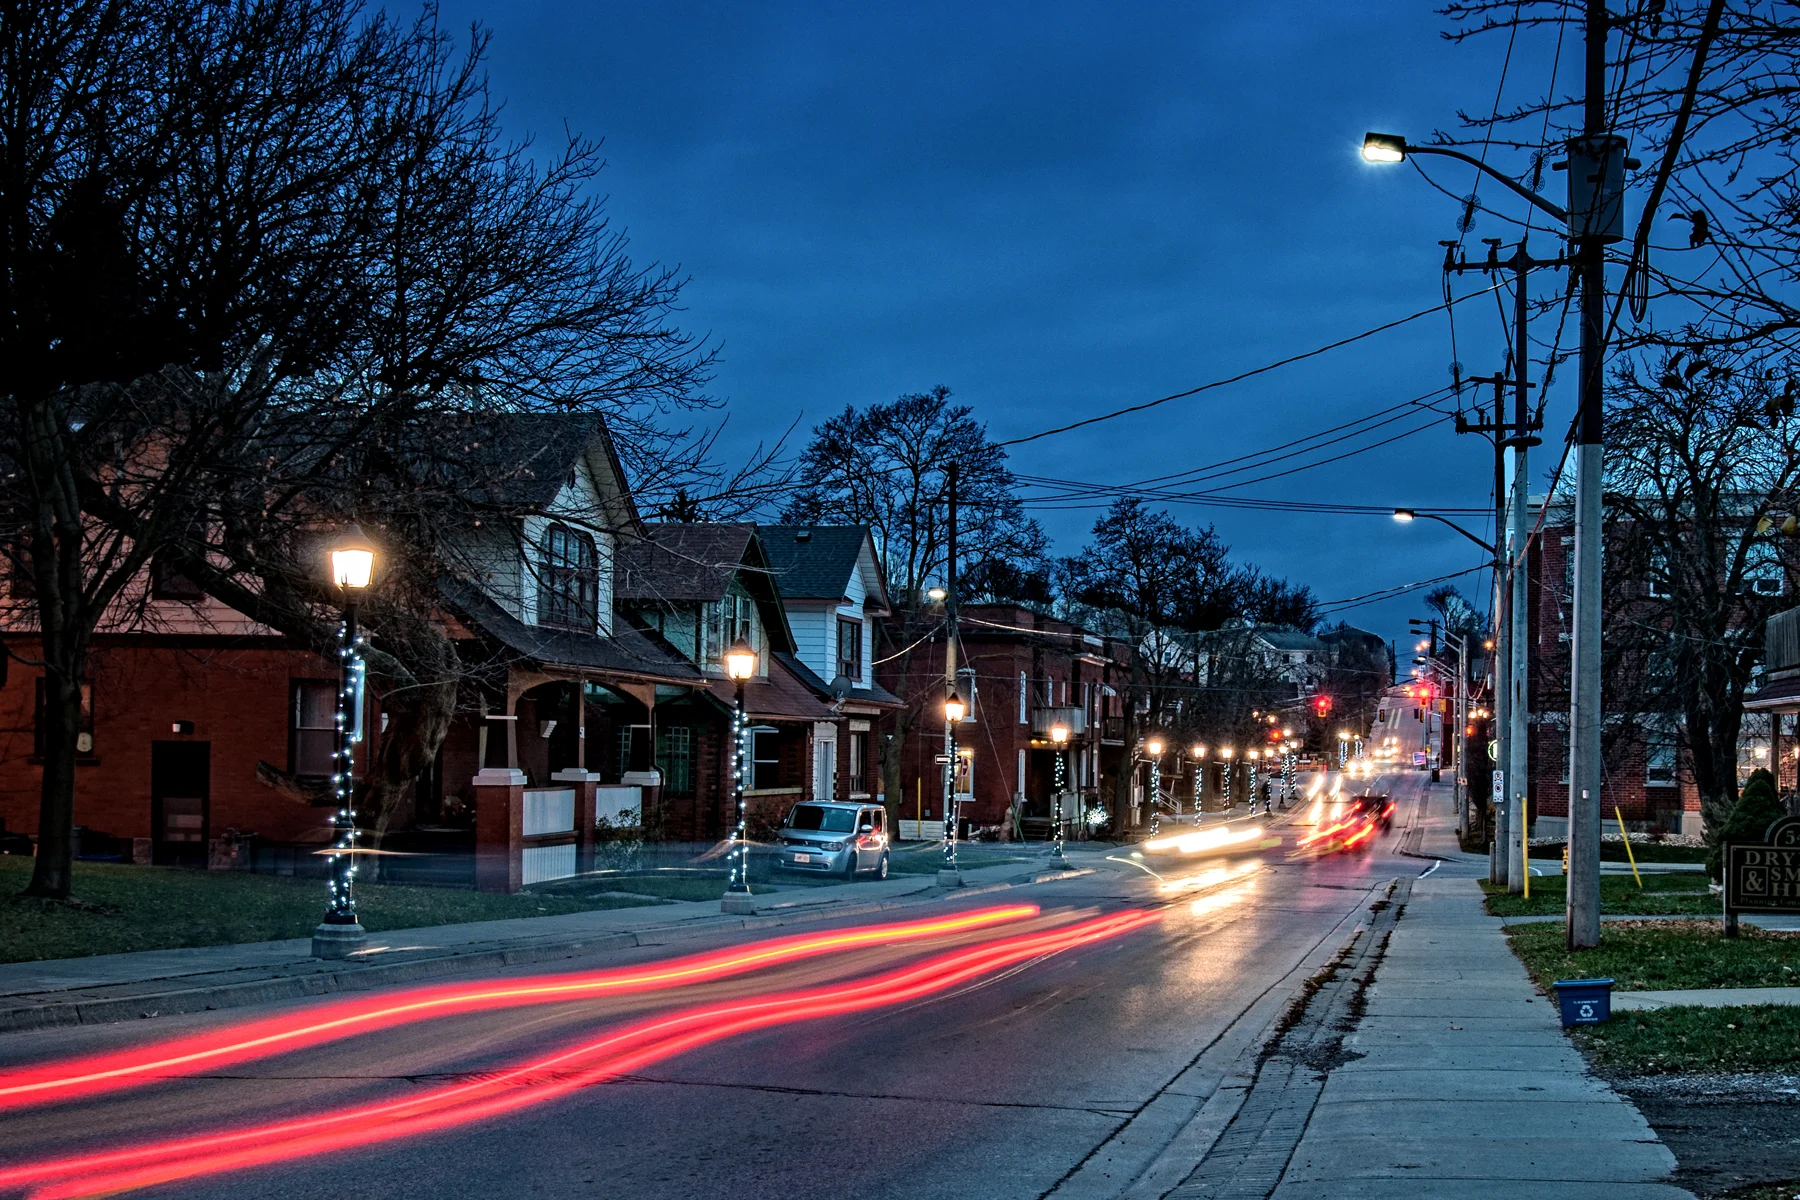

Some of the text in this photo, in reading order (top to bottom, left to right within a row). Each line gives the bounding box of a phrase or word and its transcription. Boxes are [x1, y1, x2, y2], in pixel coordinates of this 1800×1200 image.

[1745, 850, 1800, 866] DRY
[1746, 870, 1764, 892] &
[1740, 896, 1778, 907] Planning
